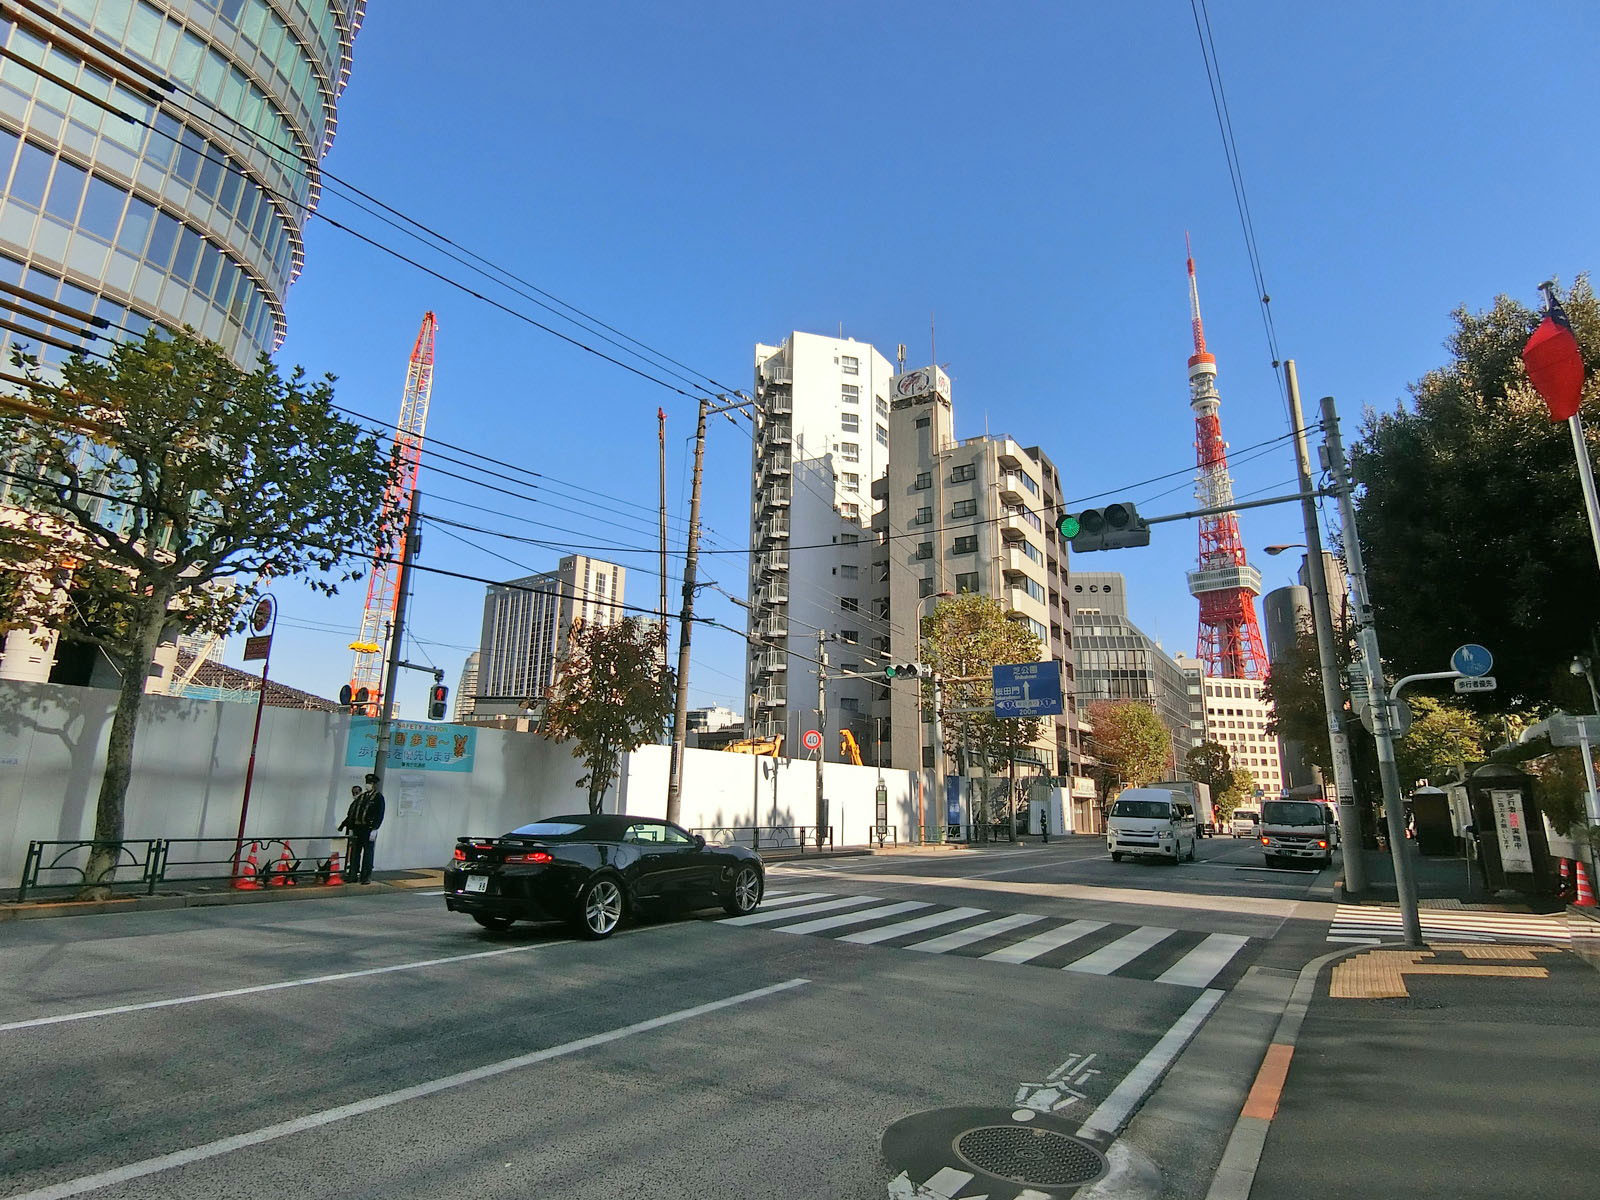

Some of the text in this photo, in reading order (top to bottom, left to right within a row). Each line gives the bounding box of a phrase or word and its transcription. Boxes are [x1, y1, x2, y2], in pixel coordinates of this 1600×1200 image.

[1013, 665, 1037, 675] 芝公園
[1459, 680, 1493, 688] 歩行者優先
[995, 686, 1020, 695] 桜田門
[397, 722, 422, 730] SAFETY
[807, 735, 818, 744] 40
